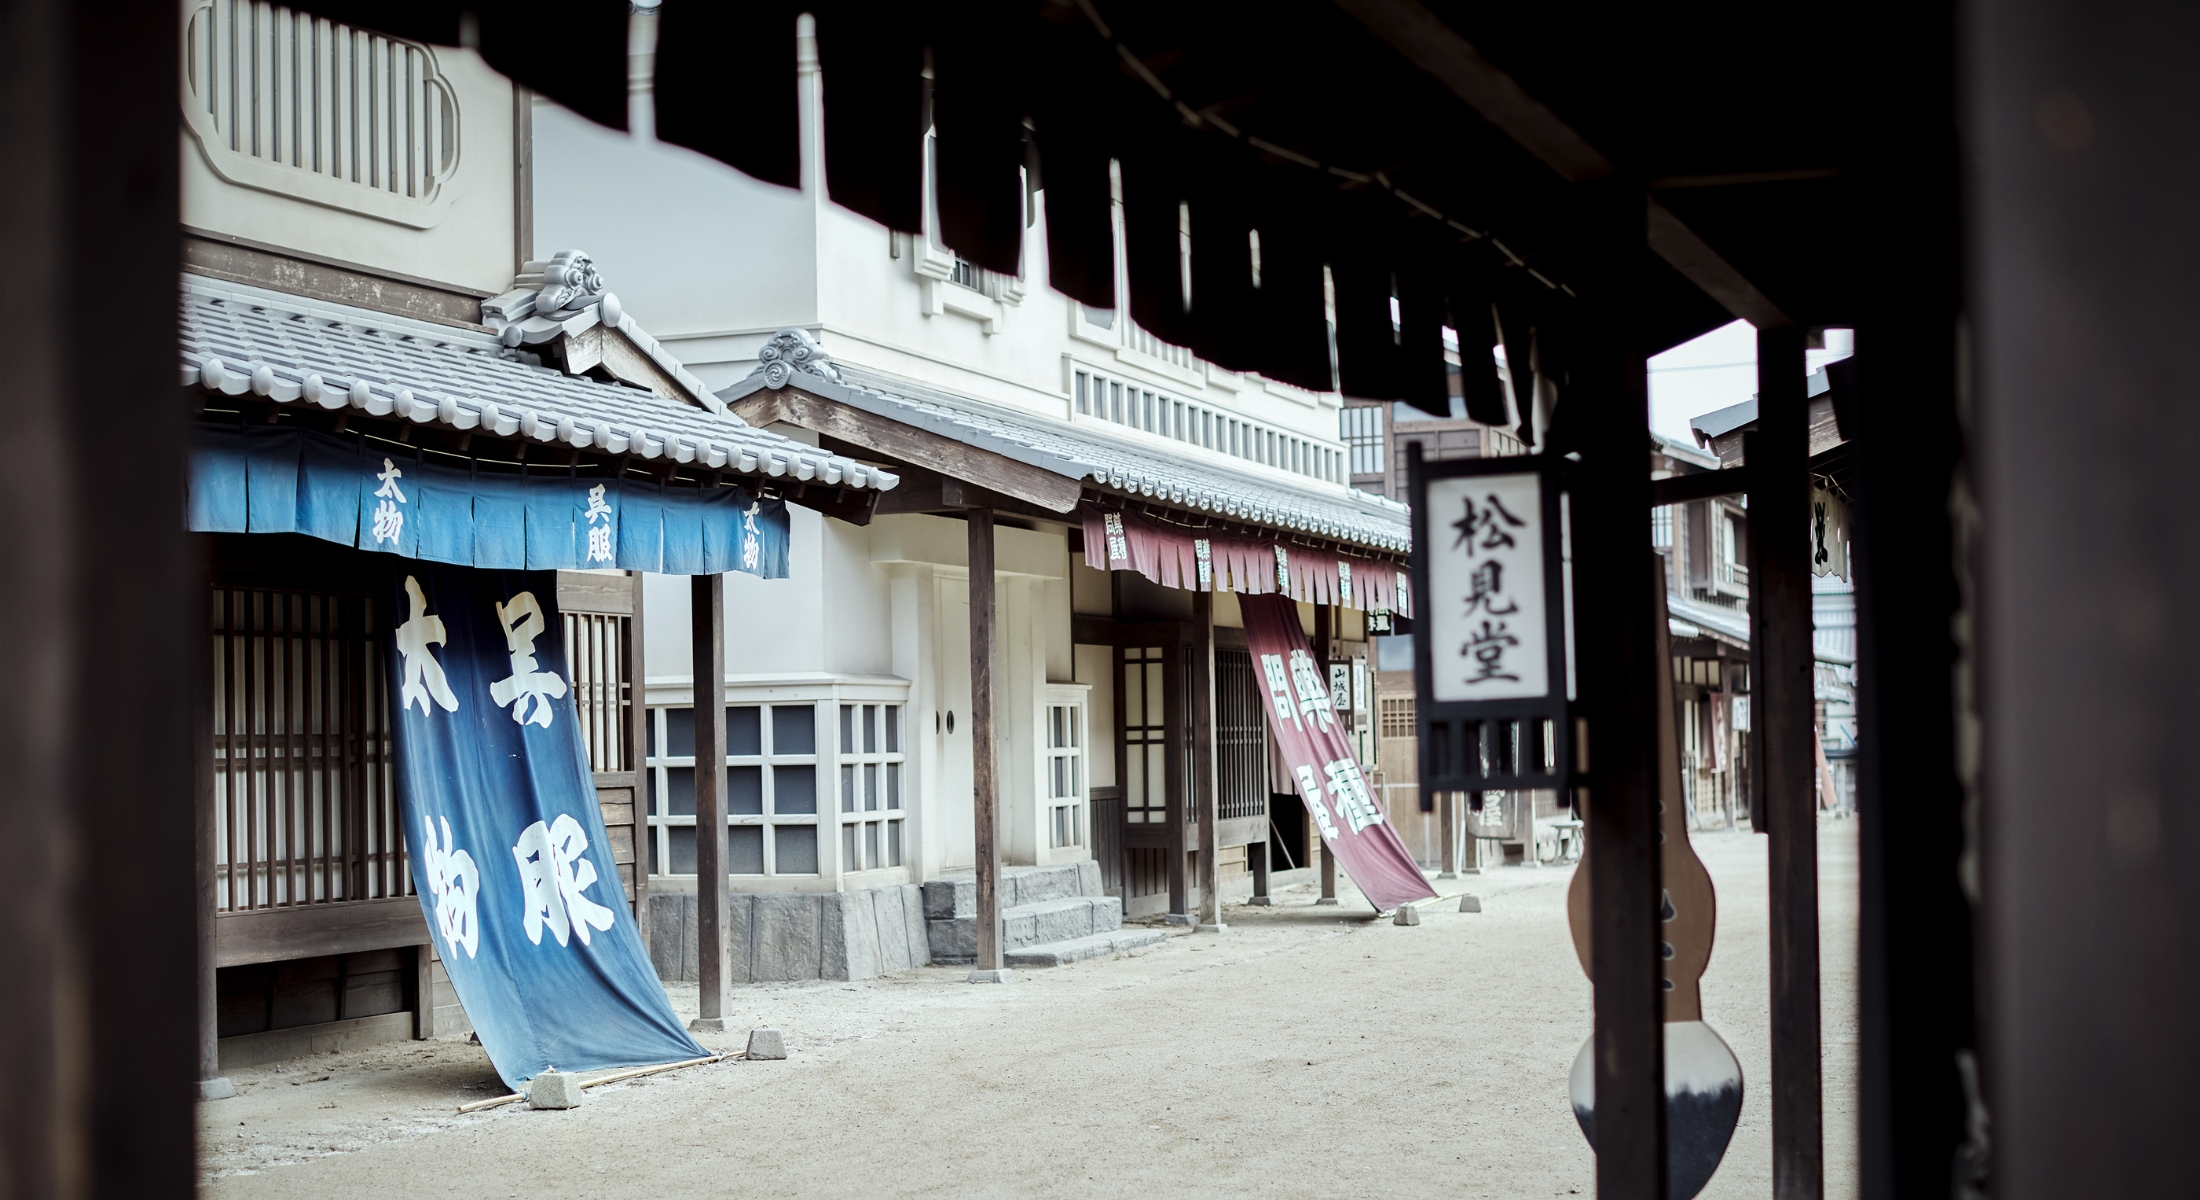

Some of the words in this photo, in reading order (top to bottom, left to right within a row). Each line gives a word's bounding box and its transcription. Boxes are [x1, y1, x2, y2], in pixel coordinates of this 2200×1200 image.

[372, 457, 407, 544] 太物
[584, 482, 613, 563] 呉服
[743, 500, 760, 571] 太物
[1450, 494, 1528, 686] 松見堂
[1333, 668, 1347, 707] 山城屋
[395, 574, 482, 960] 太物
[490, 590, 614, 947] 呉服
